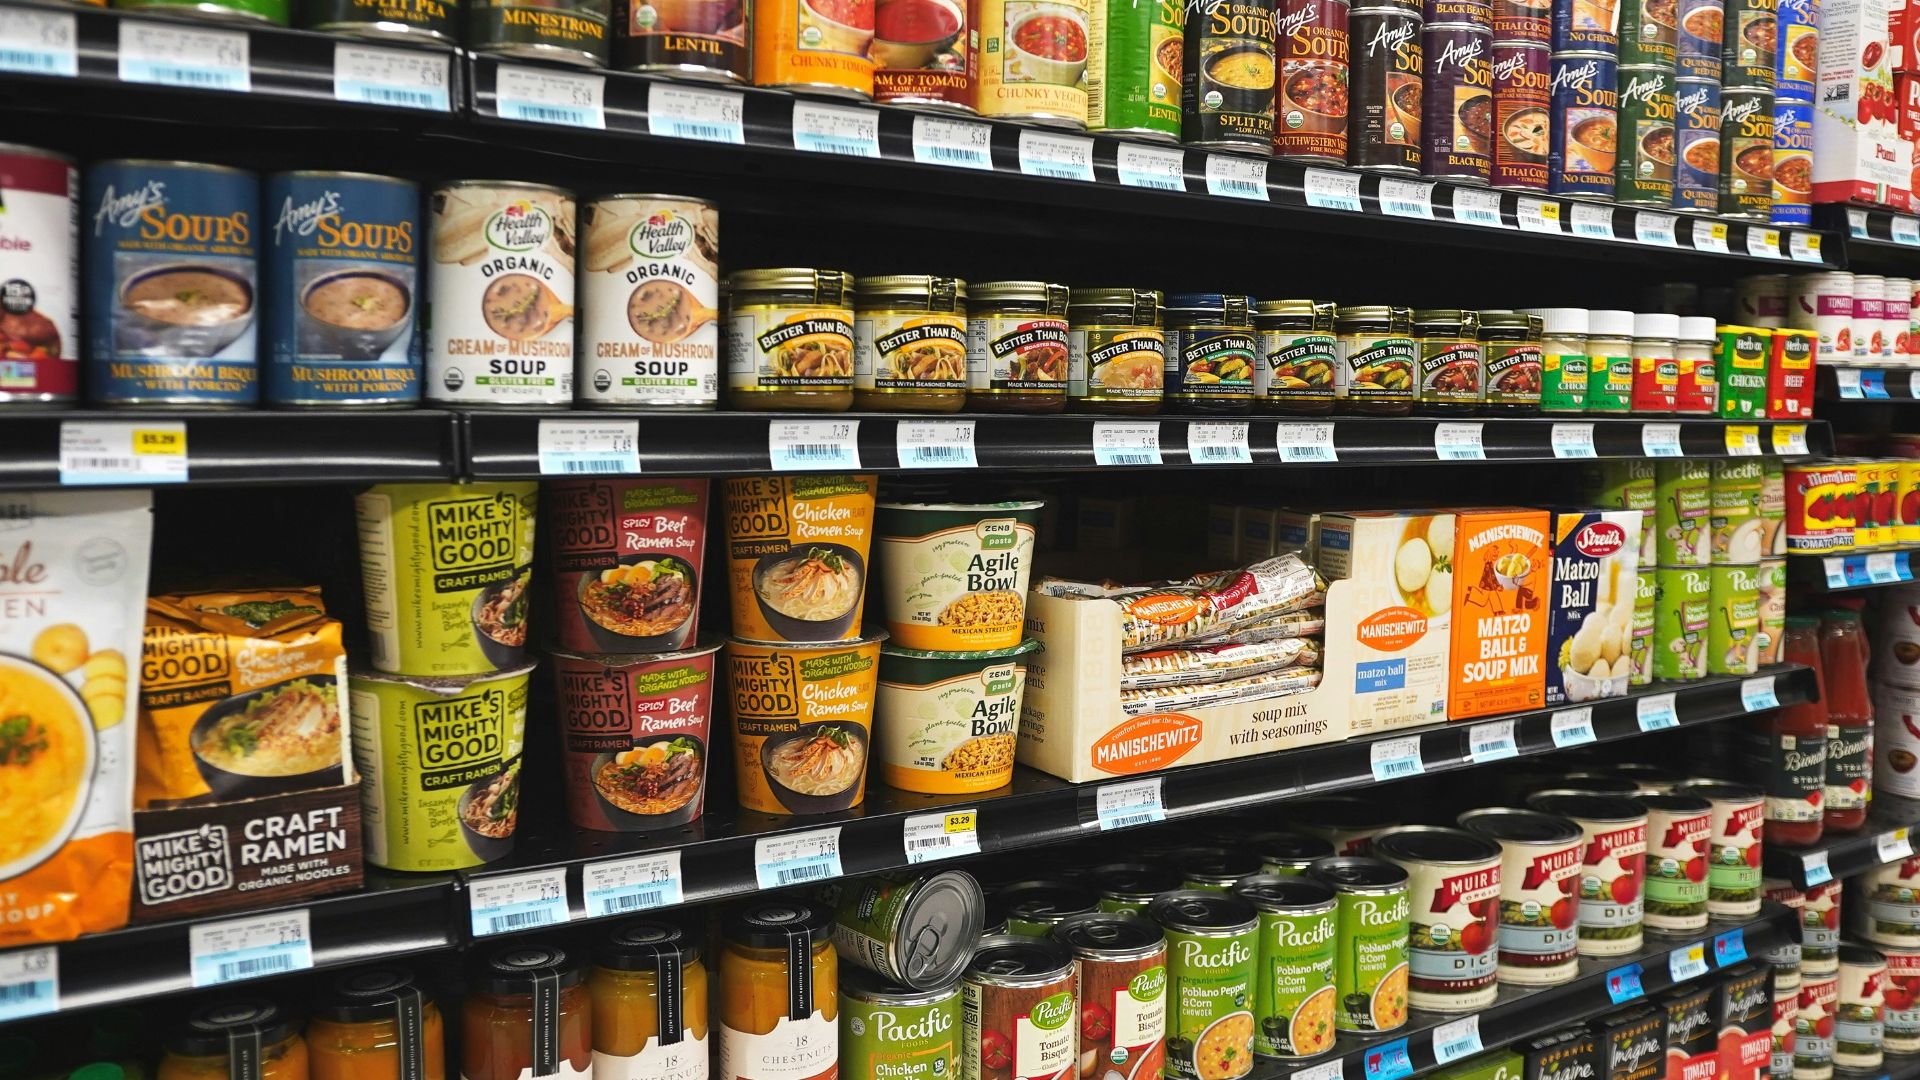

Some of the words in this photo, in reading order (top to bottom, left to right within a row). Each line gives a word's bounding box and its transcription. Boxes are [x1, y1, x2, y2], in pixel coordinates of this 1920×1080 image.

[1233, 4, 1269, 18] ORGANIC
[1437, 4, 1464, 14] BLACK
[503, 8, 604, 39] MINESTRONE
[1494, 21, 1521, 32] THAI
[664, 35, 723, 55] LENTIL
[1367, 21, 1415, 57] Amy's
[1569, 32, 1584, 41] NO
[897, 75, 914, 86] OF
[918, 74, 968, 90] TOMATO
[997, 86, 1049, 100] CHUNKY
[1220, 114, 1255, 127] SPLIT
[1720, 96, 1762, 126] Amy's
[971, 131, 987, 146] 5.19
[1274, 135, 1337, 148] SOUTHWESTERN
[1449, 155, 1474, 166] BLACK
[1501, 167, 1526, 178] THAI
[1562, 173, 1578, 183] NO
[95, 180, 168, 237] Amy's
[273, 190, 344, 246] Amy's
[140, 204, 250, 244] SOUPS
[496, 212, 542, 231] Health
[639, 221, 684, 241] Health
[318, 214, 413, 253] SOUPS
[648, 238, 687, 255] Valley
[481, 256, 554, 281] ORGANIC
[626, 262, 696, 286] ORGANIC
[761, 326, 804, 349] BETTER
[806, 321, 836, 333] THAN
[880, 330, 920, 353] BETTER
[923, 326, 949, 338] THAN
[994, 332, 1033, 355] BETTER
[1037, 329, 1059, 341] THAN
[447, 339, 495, 355] CREAM
[1091, 343, 1129, 365] BETTER
[1131, 340, 1153, 350] THAN
[1186, 342, 1222, 361] BETTER
[1223, 338, 1244, 349] THAN
[1271, 347, 1306, 366] BETTER
[1308, 344, 1328, 354] THAN
[1387, 346, 1407, 356] THAN
[489, 359, 547, 375] SOUP
[634, 361, 689, 376] SOUP
[1424, 353, 1456, 370] BETTER
[1488, 357, 1520, 373] BETTER
[1522, 353, 1537, 363] THAN
[1728, 374, 1766, 388] CHICKEN
[1784, 375, 1806, 388] BEEF
[142, 433, 175, 445] $5.29
[832, 424, 849, 437] 7.79
[955, 427, 970, 440] 7.79
[1232, 429, 1244, 440] 5.69
[434, 498, 513, 526] MIKE'S
[792, 502, 851, 521] Chicken
[437, 518, 512, 544] MIGHTY
[622, 517, 651, 529] SPICY
[654, 516, 688, 534] Beef
[796, 520, 843, 538] Ramen
[988, 537, 1012, 547] pasta
[1467, 524, 1545, 553] MANISCHEWITZ
[439, 537, 512, 565] GOOD
[754, 544, 788, 554] RAMEN
[968, 551, 1019, 577] Agile
[1555, 557, 1599, 582] Matzo
[438, 576, 477, 589] CRAFT
[478, 569, 513, 584] RAMEN
[967, 571, 1017, 592] Bowl
[1567, 610, 1582, 621] Mix
[1360, 618, 1426, 640] MANISCHEWITZ
[1477, 613, 1531, 638] MATZO
[1479, 637, 1517, 660] BALL
[143, 652, 222, 682] GOOD
[805, 658, 830, 668] MADE
[831, 654, 853, 665] WITH
[1462, 661, 1507, 684] SOUP
[1509, 655, 1539, 677] MIX
[640, 672, 666, 683] MADE
[667, 668, 689, 680] WITH
[1357, 667, 1387, 680] matzo
[1387, 663, 1404, 676] ball
[638, 680, 678, 693] ORGANIC
[801, 681, 858, 701] Chicken
[992, 681, 1012, 692] pasta
[1374, 677, 1388, 687] mix
[422, 694, 499, 726] MIKE'S
[637, 700, 665, 712] SPICY
[737, 693, 792, 713] GOOD
[806, 700, 850, 718] Ramen
[971, 695, 1017, 721] Agile
[1251, 708, 1283, 724] soup
[1285, 701, 1308, 717] mix
[424, 714, 500, 742] MIGHTY
[640, 715, 686, 733] Ramen
[687, 714, 705, 727] Soup
[763, 723, 797, 732] RAMEN
[971, 714, 1015, 737] Bowl
[1136, 719, 1151, 729] food
[1151, 717, 1161, 725] for
[1162, 716, 1172, 724] the
[1229, 729, 1260, 747] with
[1261, 718, 1329, 742] seasonings
[426, 733, 499, 764] GOOD
[594, 739, 630, 749] RAMEN
[1097, 726, 1199, 765] MANISCHEWITZ
[465, 764, 500, 781] RAMEN
[954, 770, 985, 779] MEXICAN
[243, 806, 343, 842] CRAFT
[949, 816, 970, 826] $3.29
[1678, 818, 1706, 835] MUIR
[142, 826, 222, 862] MIKE'S
[241, 828, 347, 866] RAMEN
[1600, 829, 1635, 850] MUIR
[819, 844, 836, 857] 2.79
[144, 849, 223, 878] MIGHTY
[260, 863, 295, 877] MADE
[297, 857, 329, 871] WITH
[1540, 851, 1574, 874] MUIR
[147, 866, 225, 898] GOOD
[1450, 874, 1488, 896] MUIR
[541, 885, 560, 901] 2.79
[1271, 917, 1336, 948] Pacific
[1177, 940, 1252, 968] Pacific
[1359, 943, 1391, 955] Poblano
[1539, 954, 1562, 962] FIRE
[1276, 964, 1312, 976] Poblano
[1182, 975, 1215, 986] Organic
[1277, 984, 1307, 995] CHOWDER
[1450, 979, 1475, 988] FIRE
[1182, 986, 1219, 998] Poblano
[1037, 994, 1072, 1021] Pacific
[1182, 1008, 1213, 1017] CHOWDER
[1726, 987, 1767, 1024] Imagine
[868, 1007, 953, 1042] Pacific
[964, 1010, 978, 1023] 330
[796, 1036, 809, 1048] 18
[1039, 1034, 1070, 1051] Tomato
[1740, 1036, 1771, 1057] TOMATO
[665, 1054, 678, 1069] 18
[1610, 1036, 1661, 1073] Imagine
[875, 1062, 928, 1077] Chicken
[1683, 1059, 1716, 1080] TOMATO
